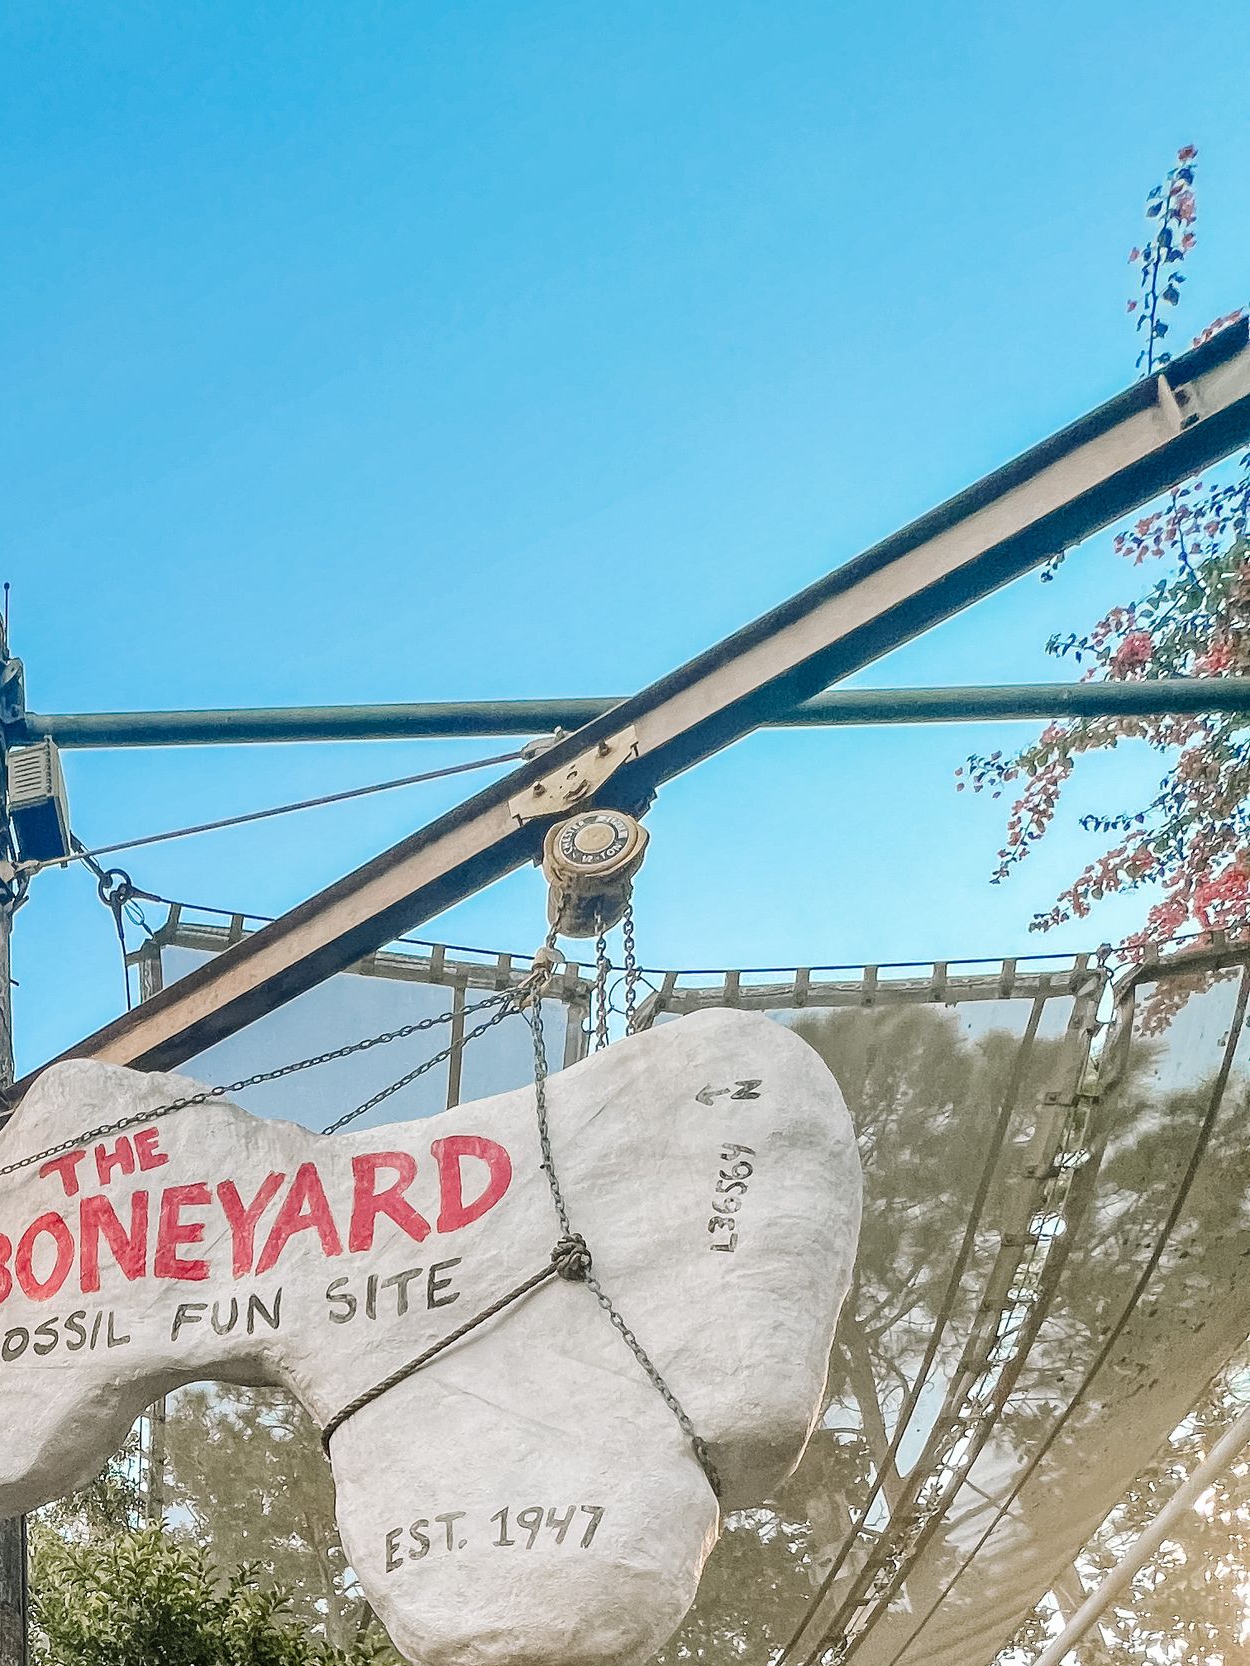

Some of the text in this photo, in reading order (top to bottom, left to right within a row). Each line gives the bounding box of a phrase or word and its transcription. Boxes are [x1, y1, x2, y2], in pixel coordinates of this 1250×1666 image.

[600, 841, 622, 860] TON
[39, 1126, 170, 1198] THE
[171, 1287, 282, 1342] FUN
[325, 1257, 463, 1324] SITE
[384, 1505, 606, 1573] EST. 1947
